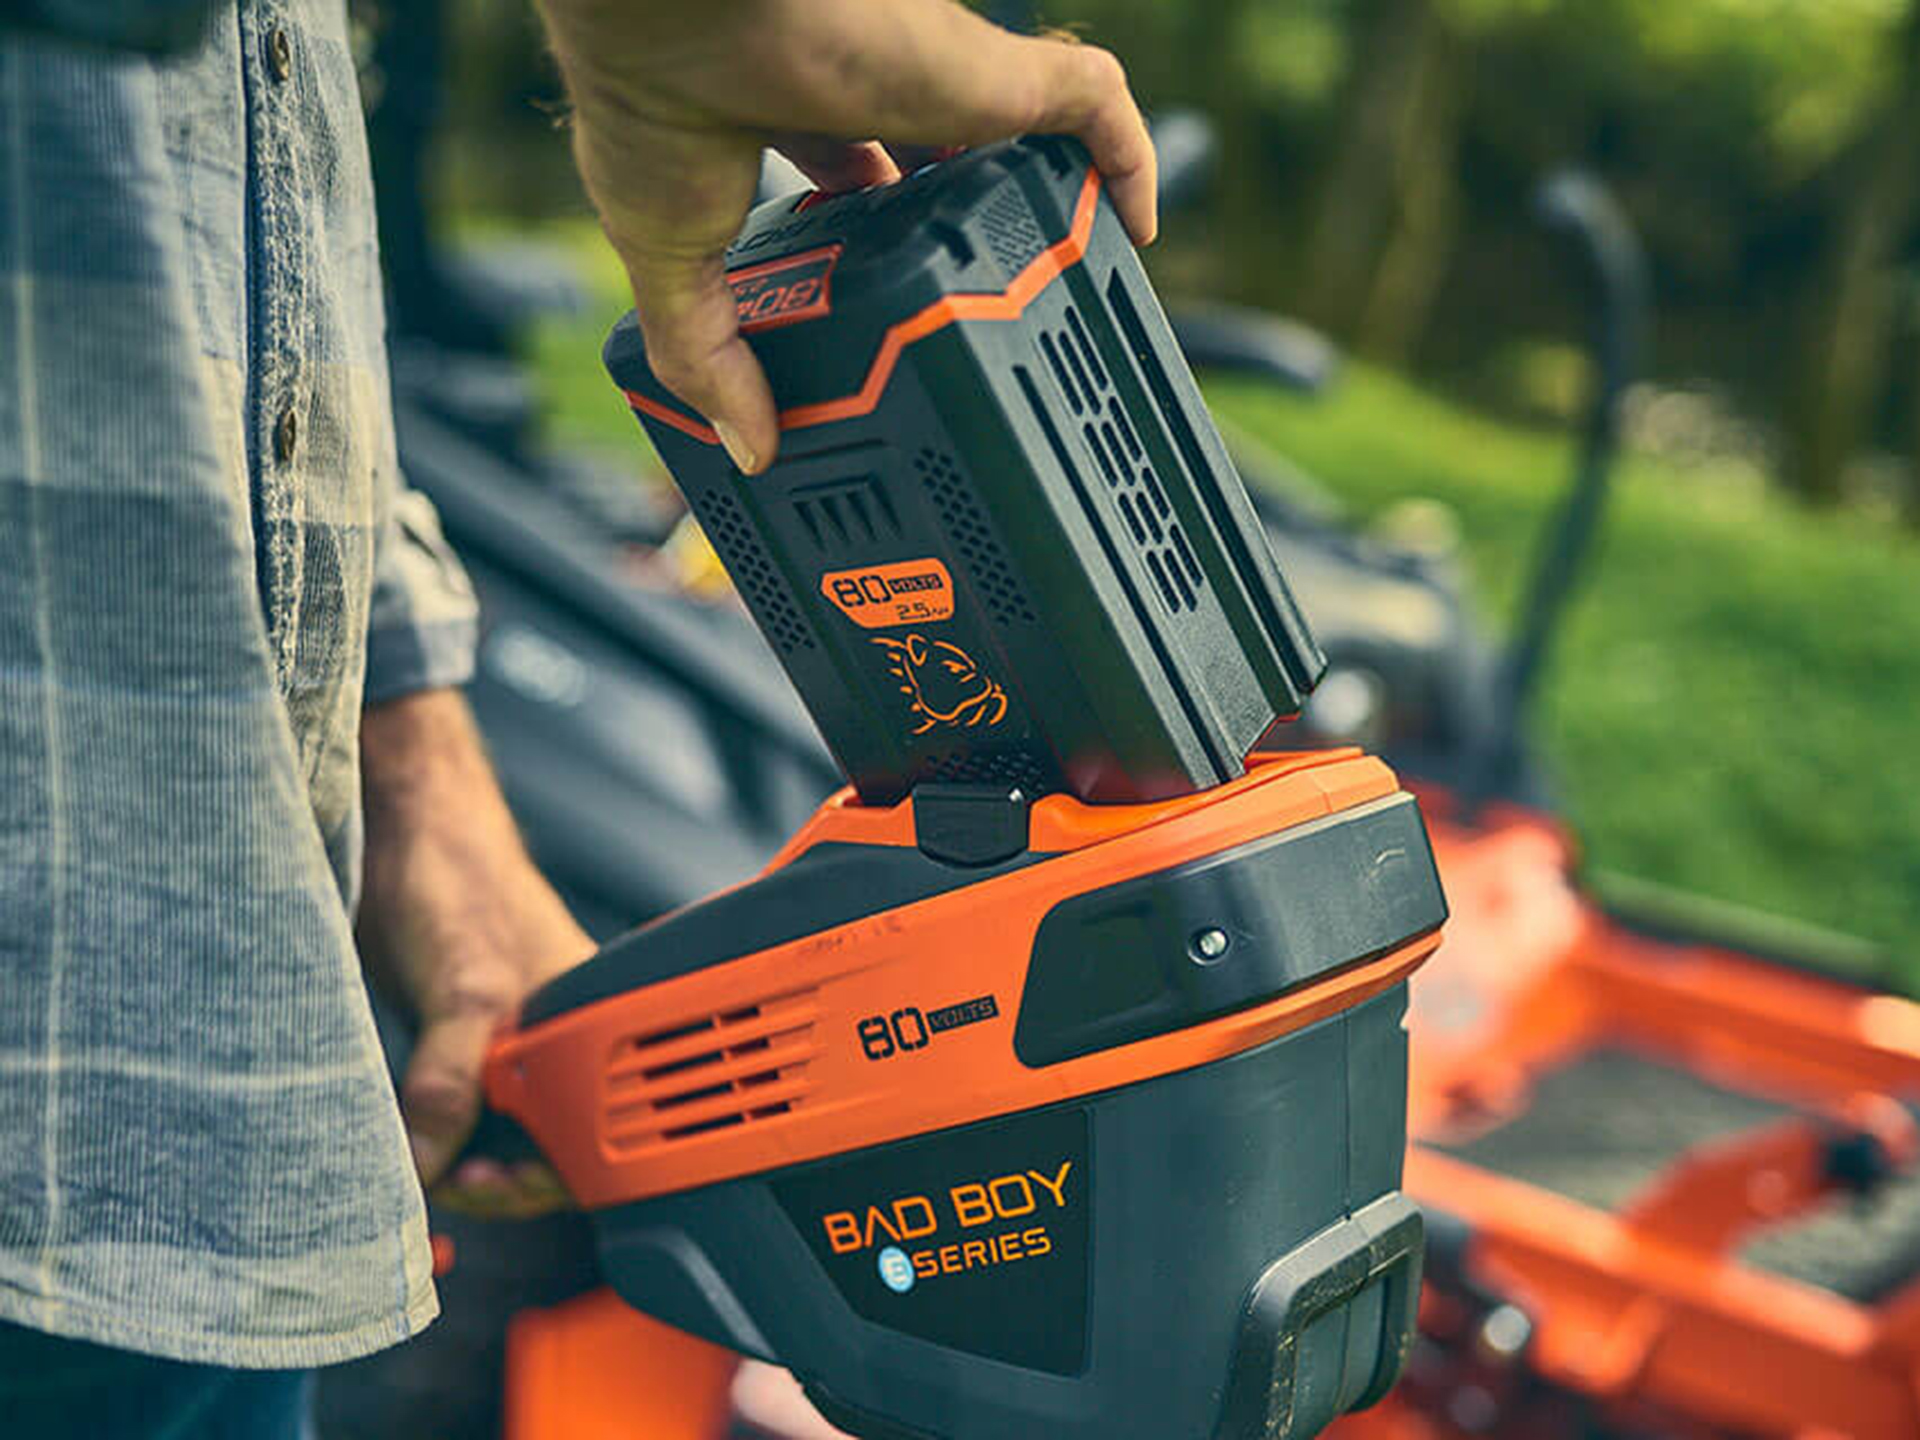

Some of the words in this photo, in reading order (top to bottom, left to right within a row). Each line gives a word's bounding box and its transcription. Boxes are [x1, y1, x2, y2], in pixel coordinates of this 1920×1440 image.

[832, 575, 892, 607] 80
[890, 575, 942, 592] VOLTS
[857, 1007, 930, 1061] 80
[929, 999, 996, 1031] VOLTS
[823, 1195, 937, 1253] BAD
[951, 1161, 1072, 1227] BOY
[912, 1227, 1051, 1278] SERIES
